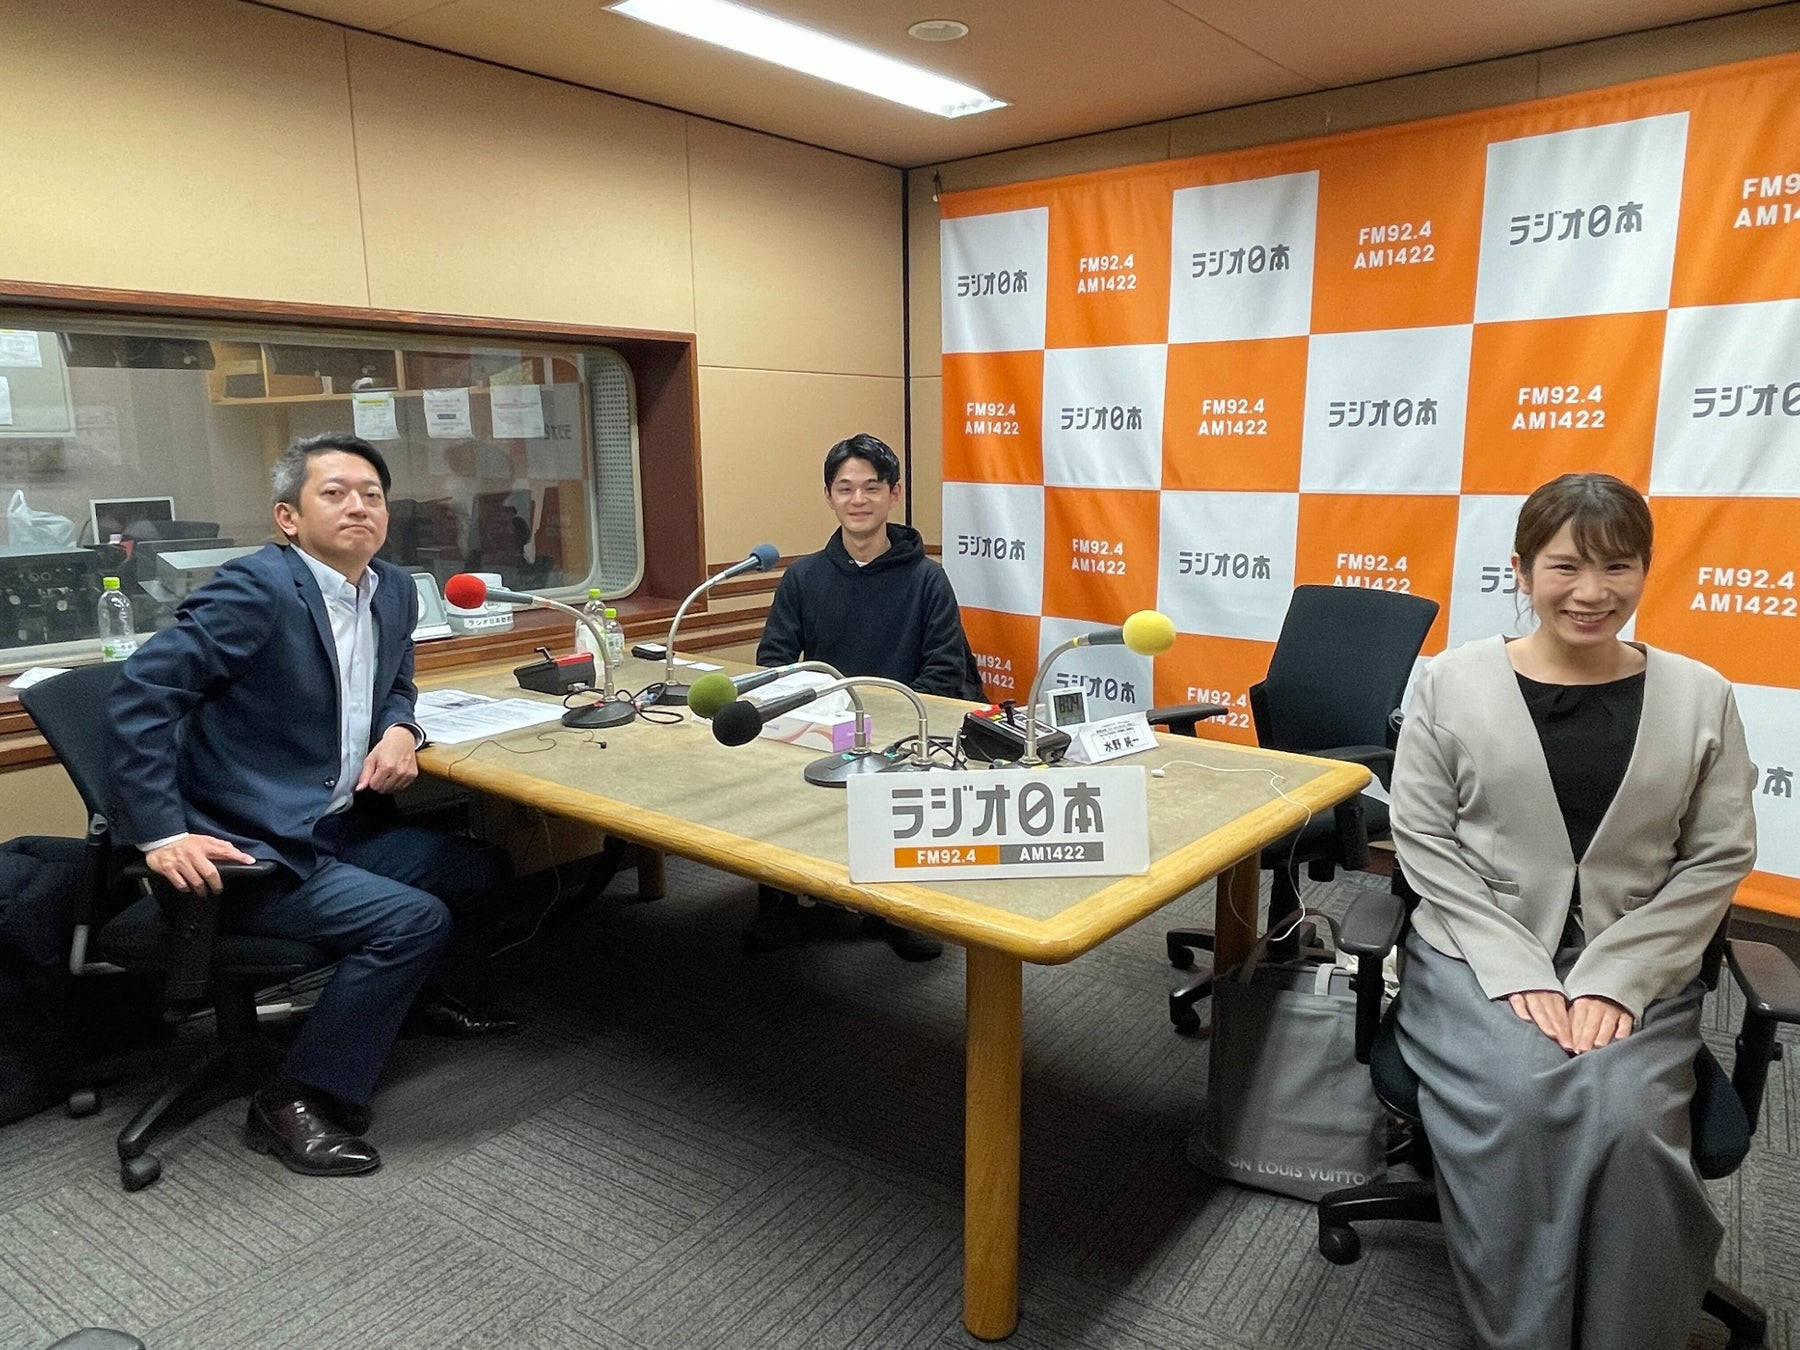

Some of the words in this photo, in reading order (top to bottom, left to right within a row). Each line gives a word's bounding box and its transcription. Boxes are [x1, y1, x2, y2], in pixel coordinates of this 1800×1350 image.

[1743, 173, 1800, 199] FM9
[1510, 202, 1643, 245] ラジオ日本
[1734, 204, 1800, 228] AM1
[1359, 220, 1432, 246] FM92.4
[1080, 254, 1134, 272] FM92.4
[1193, 244, 1289, 277] ラジオ日本
[1354, 245, 1435, 269] AM1422
[958, 270, 1028, 297] ラジオ日本
[1077, 274, 1137, 294] AM1422
[1518, 385, 1602, 406] FM92.4
[1693, 383, 1800, 418] ラジオ日
[966, 402, 1016, 416] FM92.4
[1203, 399, 1265, 415] FM92.4
[1329, 398, 1437, 427] ラジオ日本
[965, 420, 1018, 435] AM1422
[1061, 406, 1142, 431] ラジオ日本
[1198, 419, 1267, 435] AM1422
[1512, 410, 1605, 430] AM1422
[958, 535, 1026, 561] ラジオ日本
[1072, 538, 1123, 556] FM92.4
[1072, 557, 1126, 576] AM1422
[1179, 551, 1271, 580] ラジオ日本
[1337, 553, 1408, 572] FM92.4
[1333, 575, 1411, 595] AM1422
[1698, 567, 1795, 590] FM92.4
[1690, 593, 1798, 617] AM1422
[972, 653, 1012, 671] M92.4
[1187, 687, 1247, 708] FM92.4
[892, 782, 1104, 839] ラジオ日本
[917, 849, 977, 865] FM92.4
[1019, 845, 1085, 861] AM1422
[1257, 1163, 1303, 1178] LOUIS
